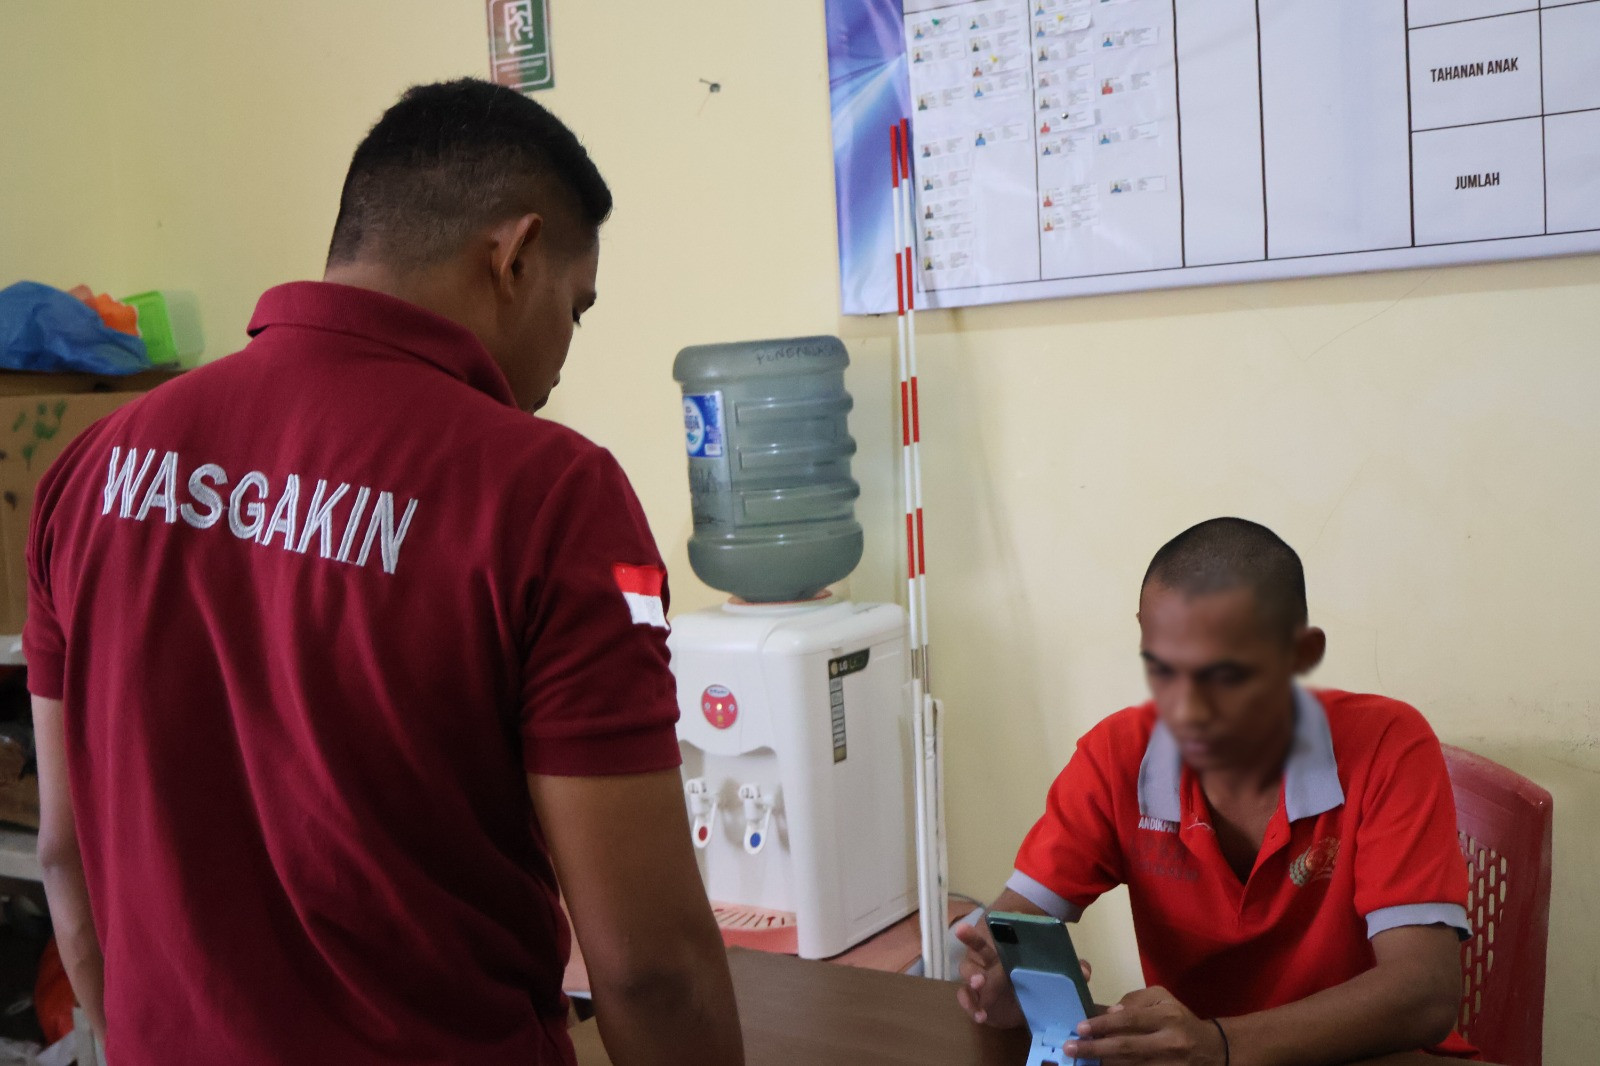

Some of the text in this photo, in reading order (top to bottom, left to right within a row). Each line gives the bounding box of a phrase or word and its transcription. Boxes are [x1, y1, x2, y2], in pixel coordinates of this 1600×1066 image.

[1430, 57, 1519, 83] TAHANAN ANAK
[1455, 172, 1500, 190] JUMLAH
[102, 446, 418, 575] WASGAKIN
